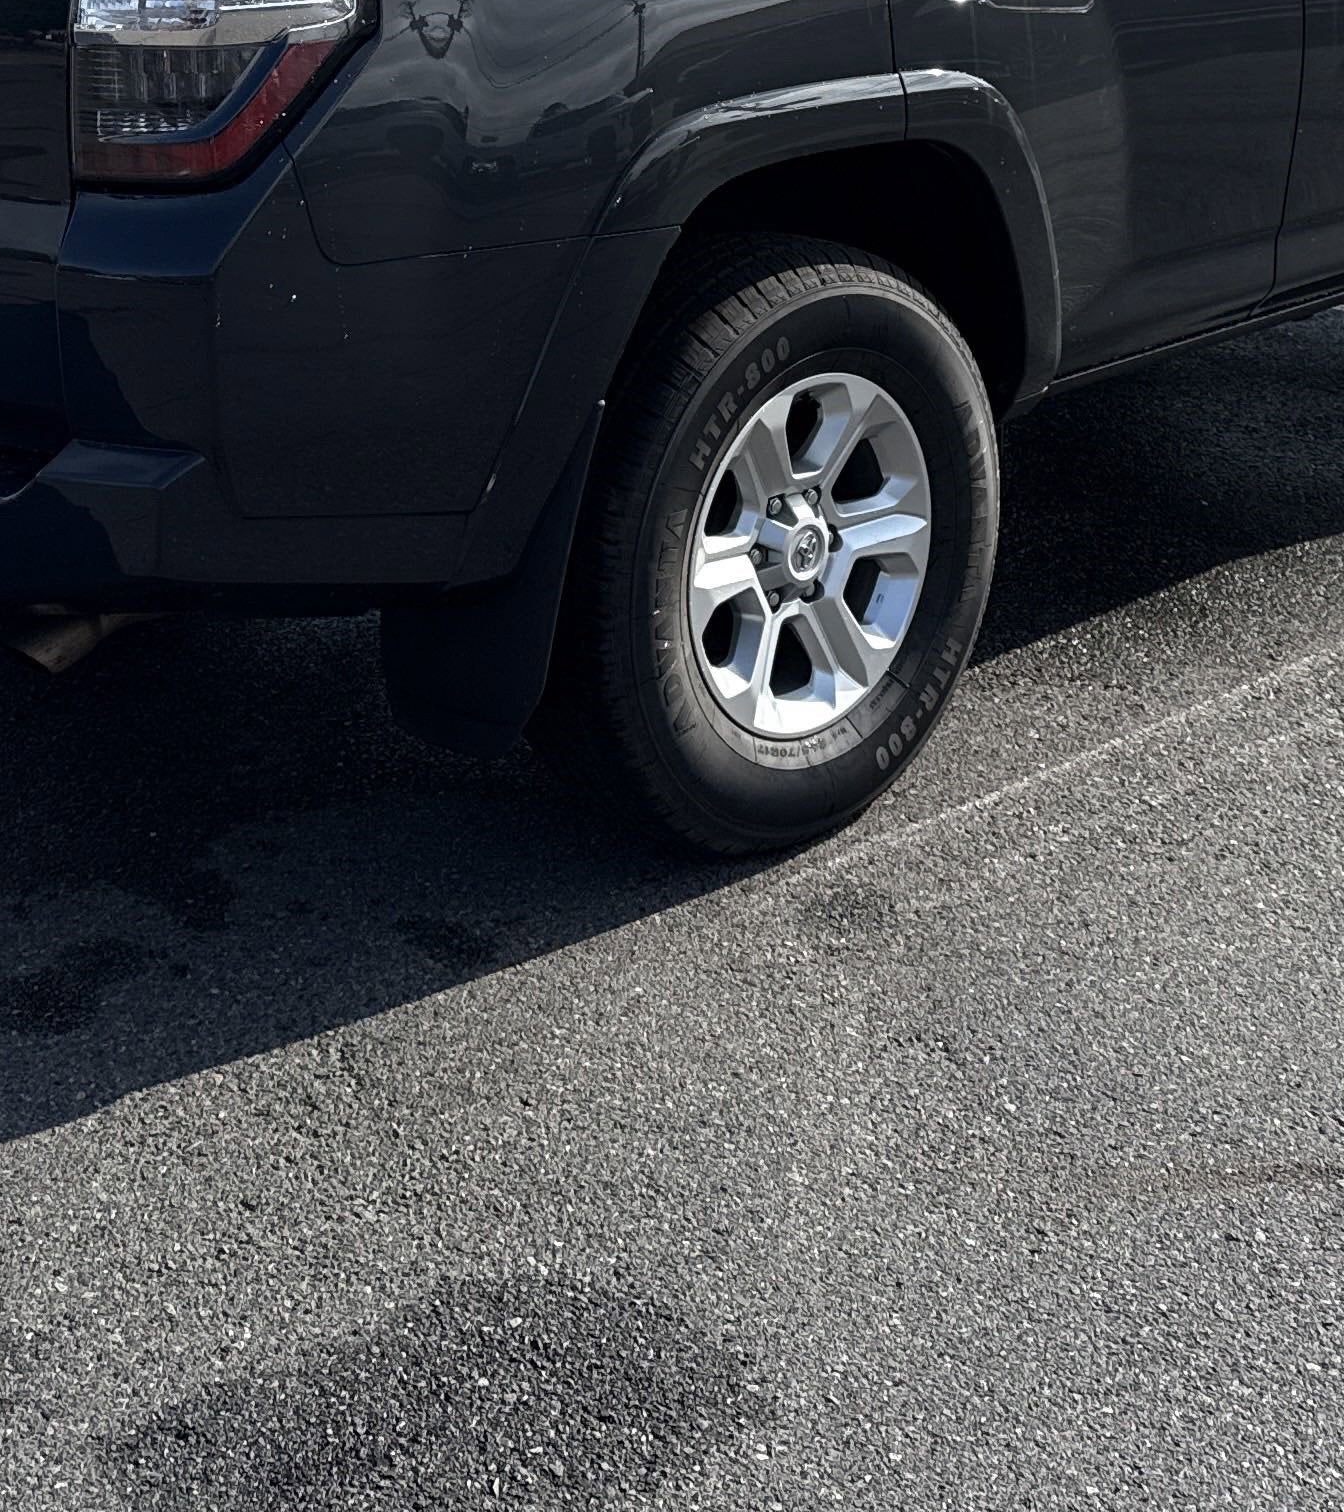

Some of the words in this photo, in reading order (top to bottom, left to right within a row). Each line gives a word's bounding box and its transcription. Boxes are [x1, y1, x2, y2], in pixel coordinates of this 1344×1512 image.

[688, 336, 791, 471] HTR-800
[655, 508, 697, 734] ADVANTA
[875, 638, 963, 771] HTR-800
